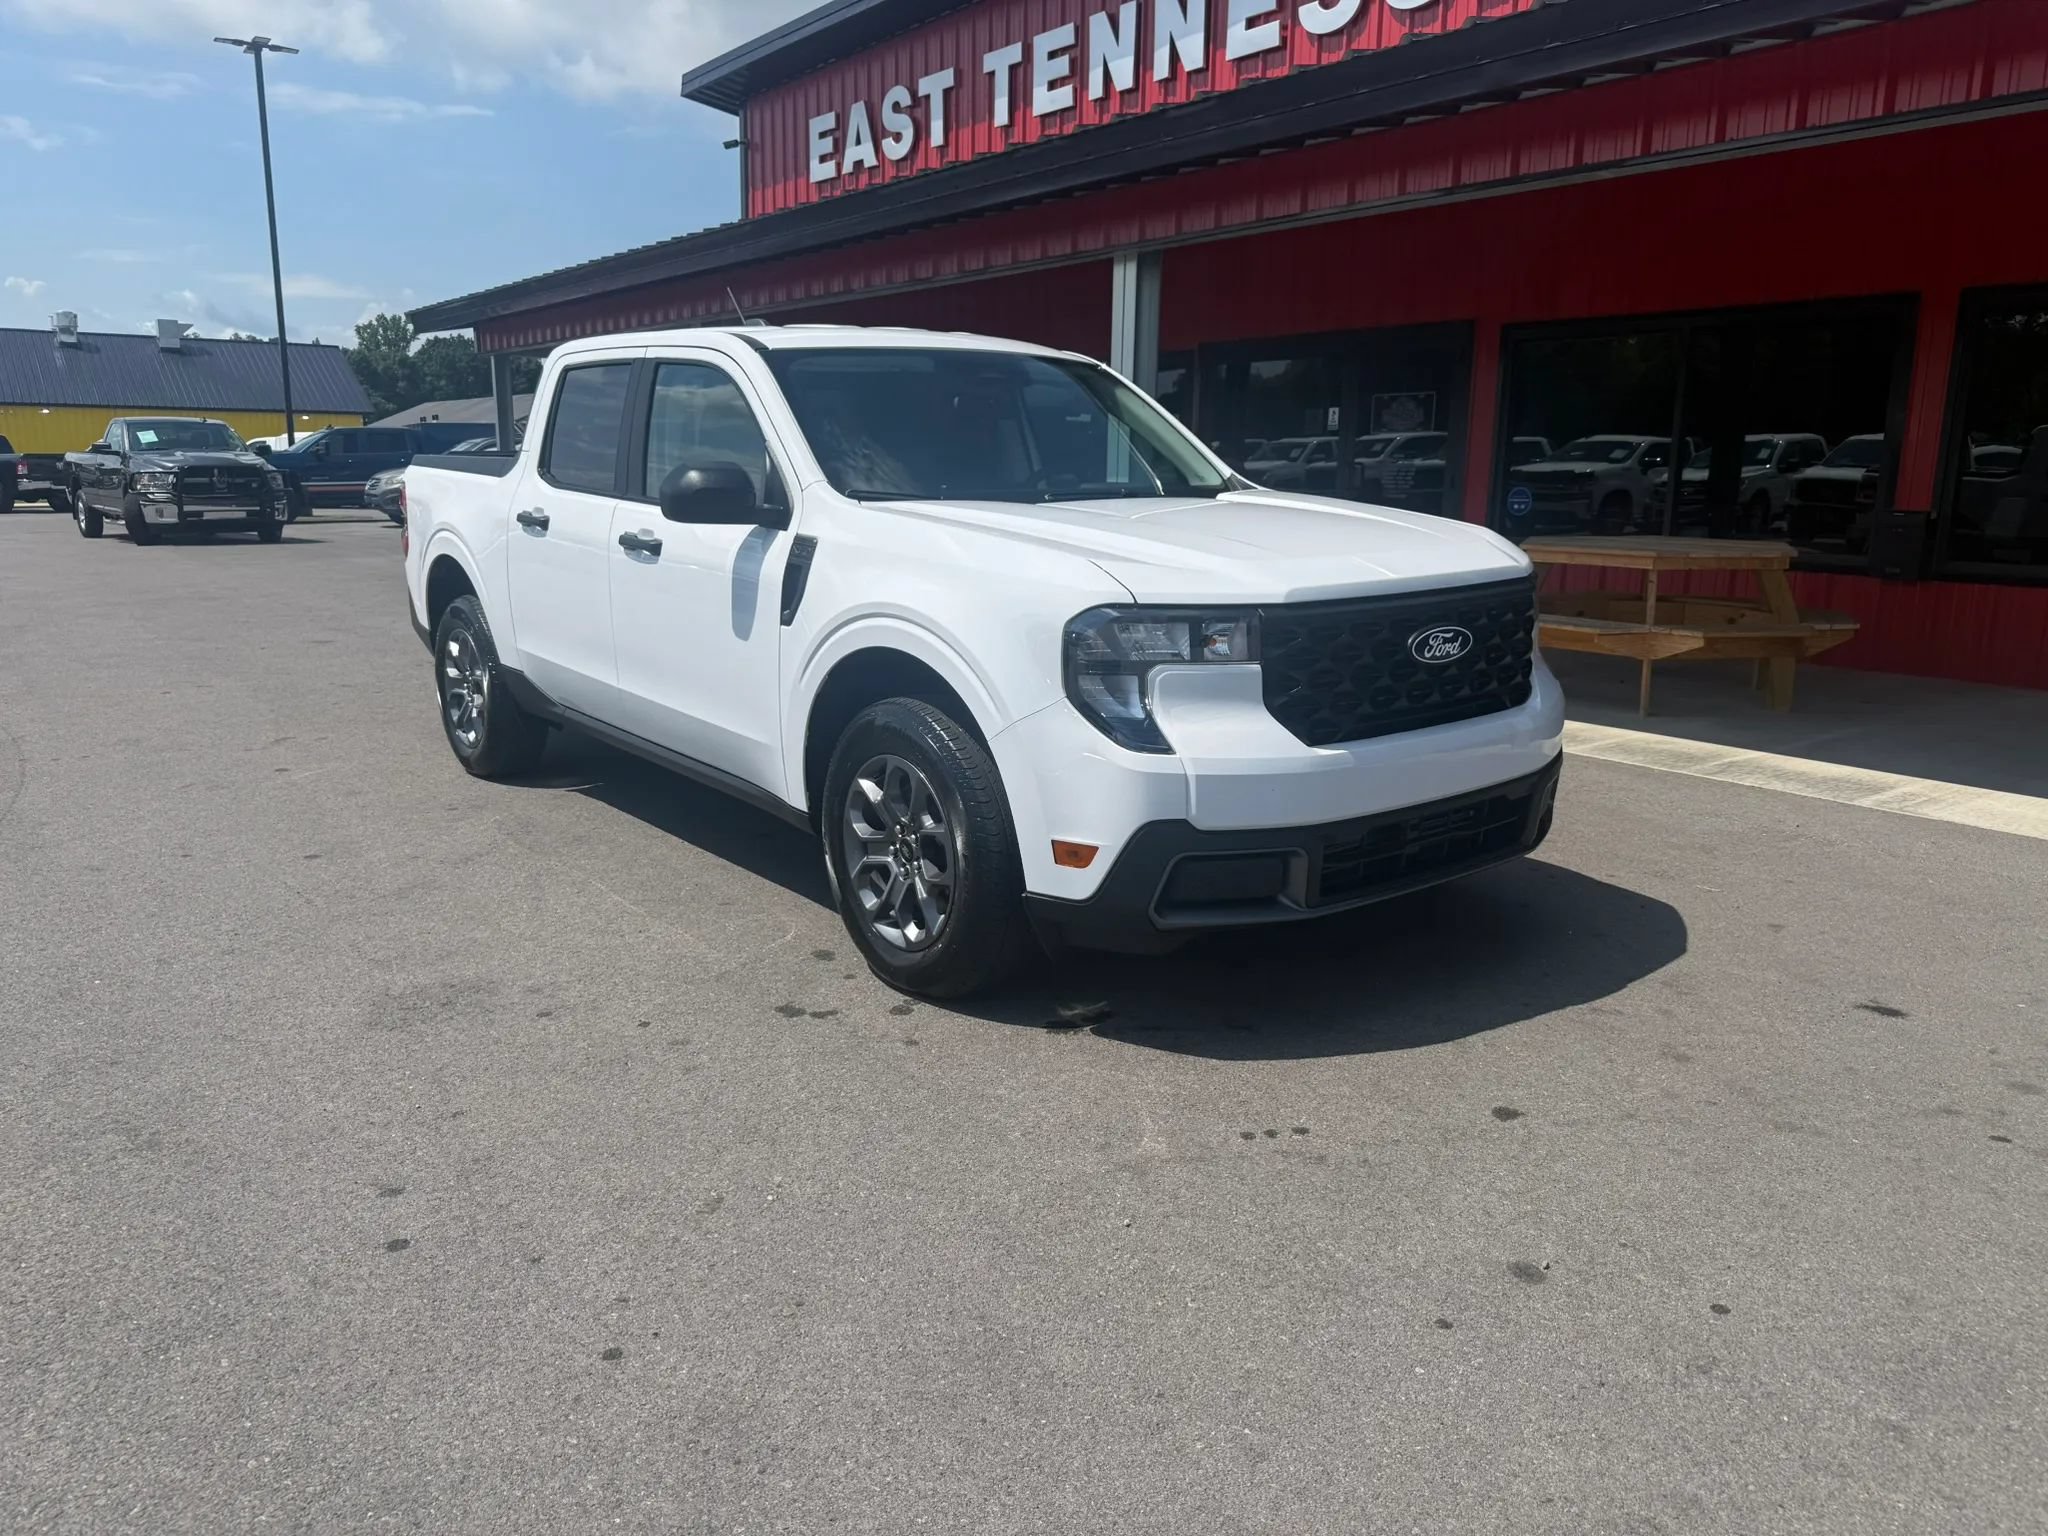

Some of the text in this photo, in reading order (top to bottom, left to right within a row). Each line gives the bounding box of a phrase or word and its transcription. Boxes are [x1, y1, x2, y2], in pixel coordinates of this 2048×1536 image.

[809, 0, 1432, 183] EAST TENNE
[1424, 632, 1462, 658] Ford
